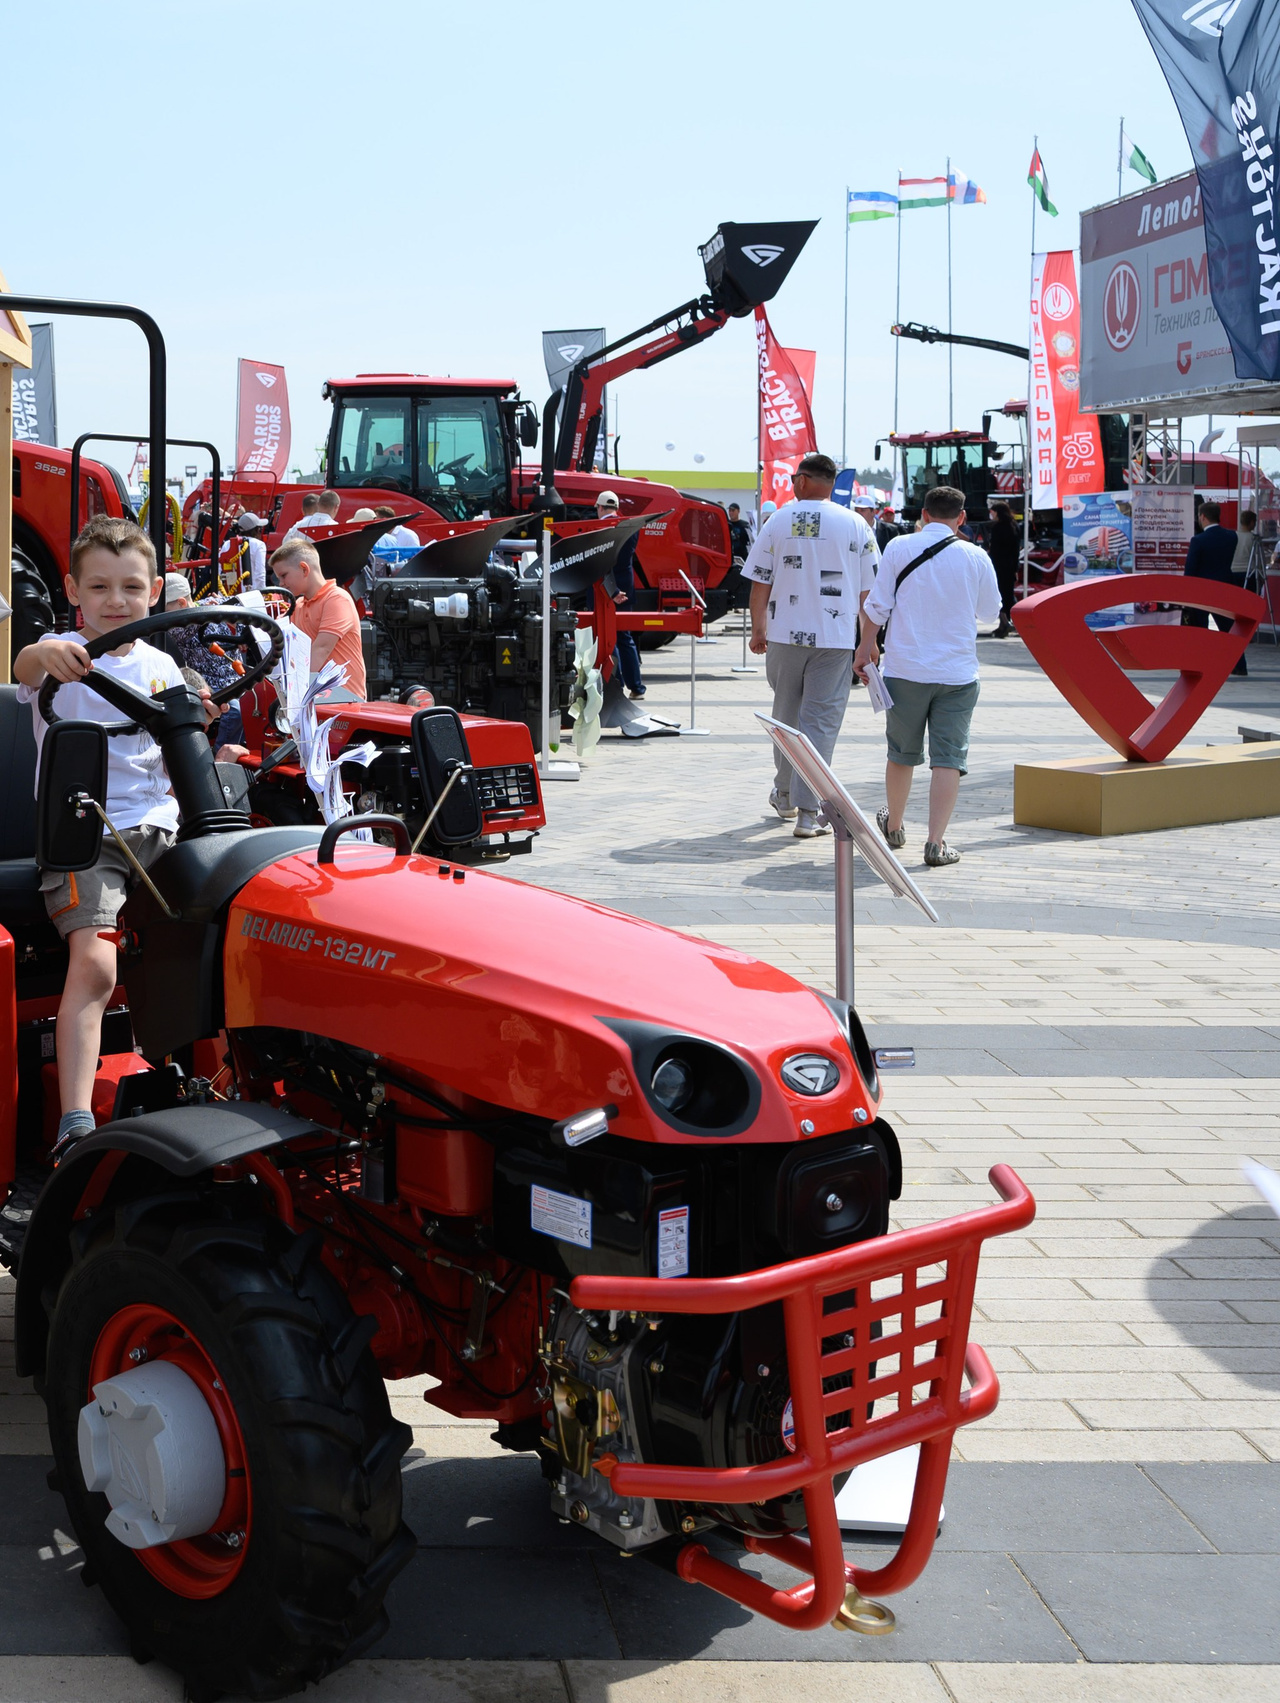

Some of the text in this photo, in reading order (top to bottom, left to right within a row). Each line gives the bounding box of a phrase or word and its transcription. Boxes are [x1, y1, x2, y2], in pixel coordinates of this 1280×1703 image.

[1137, 185, 1201, 237] Лето!
[1154, 309, 1200, 335] Техника
[243, 404, 269, 472] BELARUS
[256, 405, 282, 472] TRACTORS
[571, 432, 582, 460] BELARUS
[34, 461, 67, 477] 3522
[565, 552, 585, 567] завод
